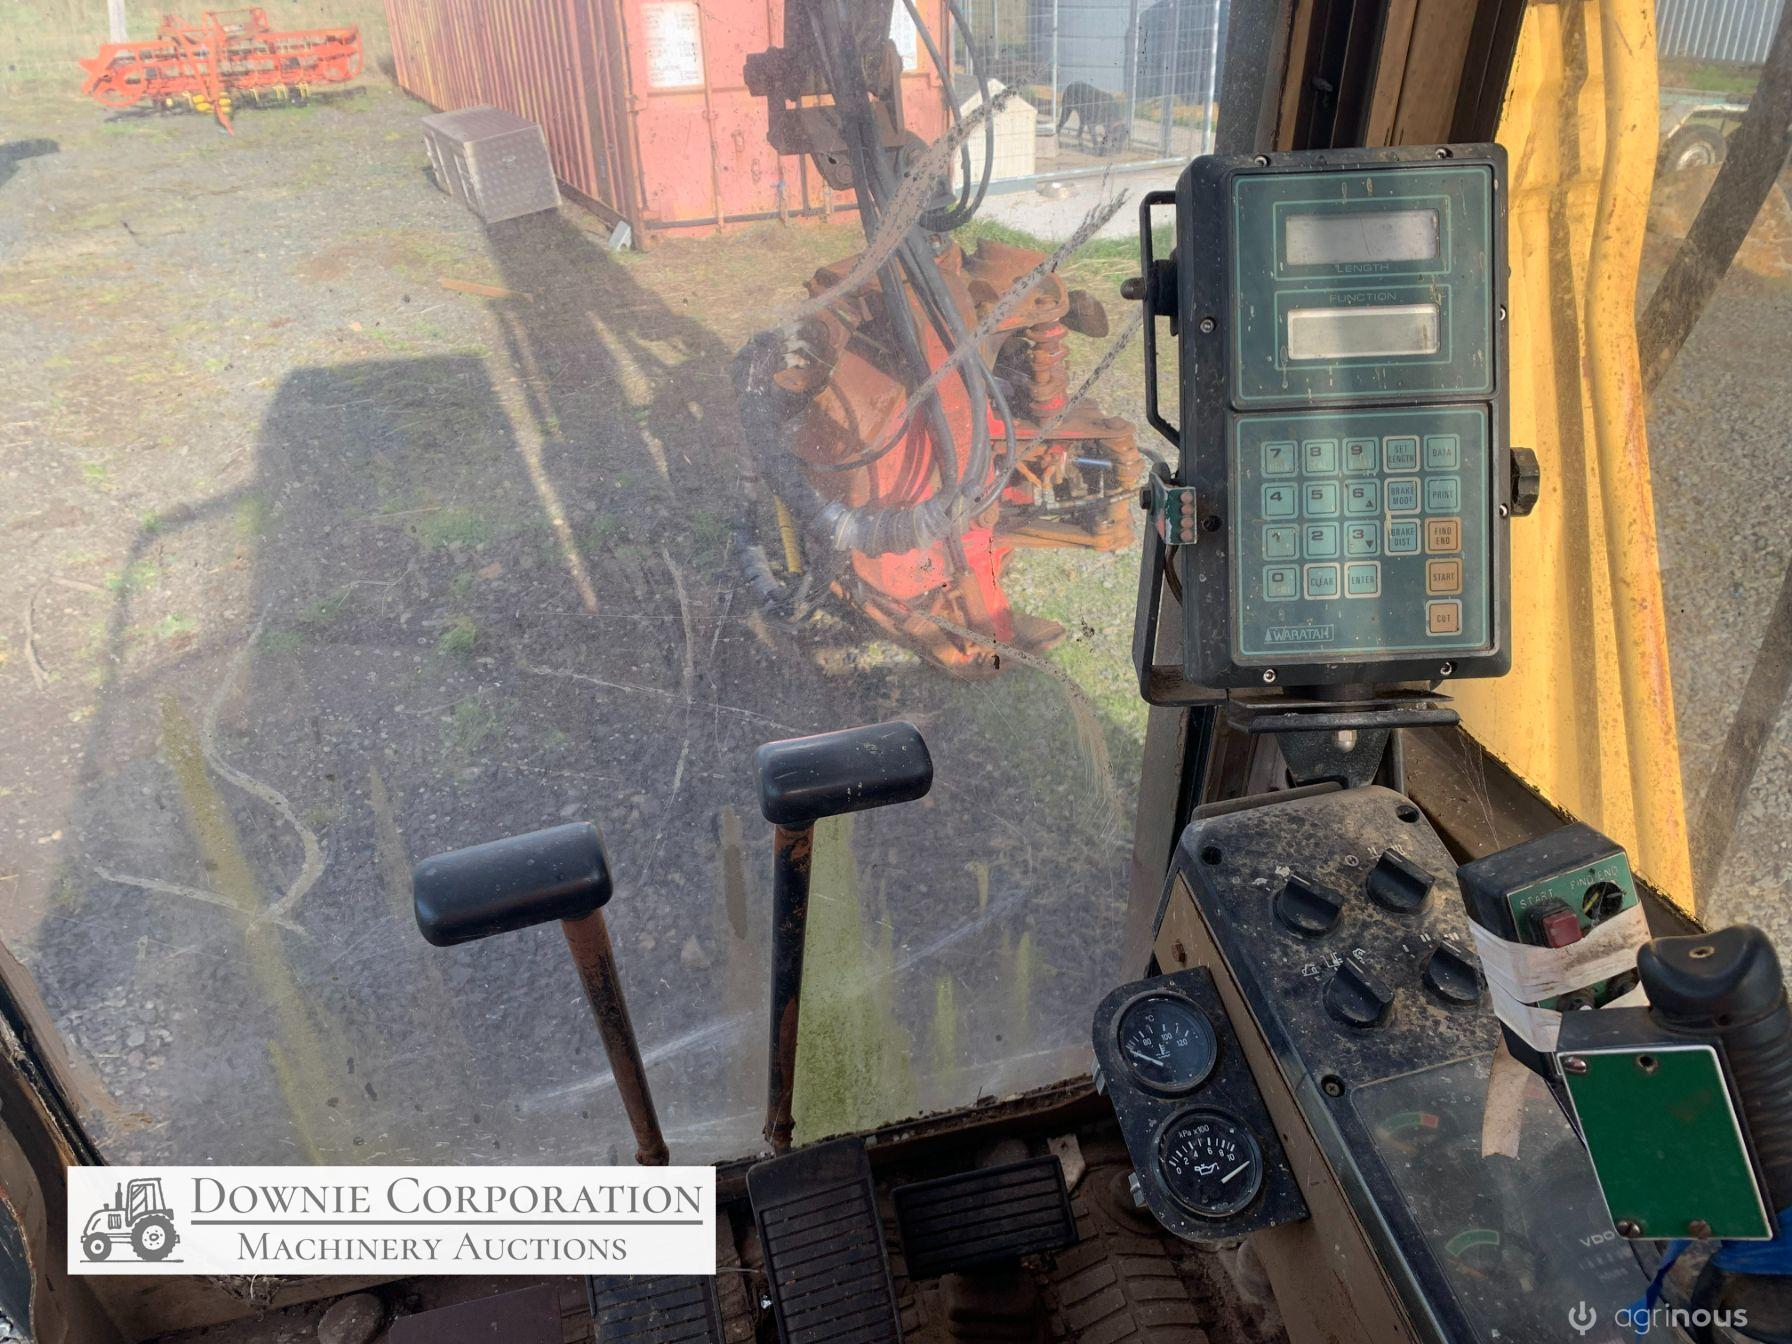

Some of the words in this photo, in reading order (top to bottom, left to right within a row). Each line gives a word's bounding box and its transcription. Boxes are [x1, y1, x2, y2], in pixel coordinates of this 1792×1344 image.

[1336, 263, 1390, 273] LENGTH
[1329, 292, 1397, 304] FUNCTION
[1269, 447, 1282, 458] 7
[1310, 446, 1322, 457] 8
[1350, 444, 1363, 456] 9
[1432, 447, 1452, 457] DATA
[1269, 491, 1282, 502] 4
[1311, 489, 1323, 500] 5
[1352, 487, 1365, 498] 6
[1432, 490, 1454, 499] PRINT
[1311, 530, 1324, 540] 2
[1352, 528, 1365, 539] 3
[1391, 527, 1414, 537] BRAKE
[1434, 526, 1452, 536] FIND
[1271, 531, 1281, 542] 1
[1271, 572, 1284, 583] 0
[1351, 575, 1375, 585] ENTER
[1432, 572, 1455, 582] START
[1436, 613, 1451, 623] CUT
[1272, 627, 1329, 641] WARATAH
[1570, 874, 1594, 890] FIND
[1597, 865, 1618, 881] END
[1519, 888, 1554, 910] START
[1142, 1037, 1152, 1046] 80
[1161, 1032, 1173, 1041] 100
[1176, 1038, 1188, 1047] 120
[1178, 1129, 1192, 1138] kPa
[1207, 1147, 1213, 1155] 6
[1218, 1149, 1225, 1157] 8
[1183, 1157, 1190, 1165] 2
[1226, 1153, 1235, 1162] 10
[1176, 1167, 1182, 1175] 0
[1579, 1230, 1616, 1248] VDO
